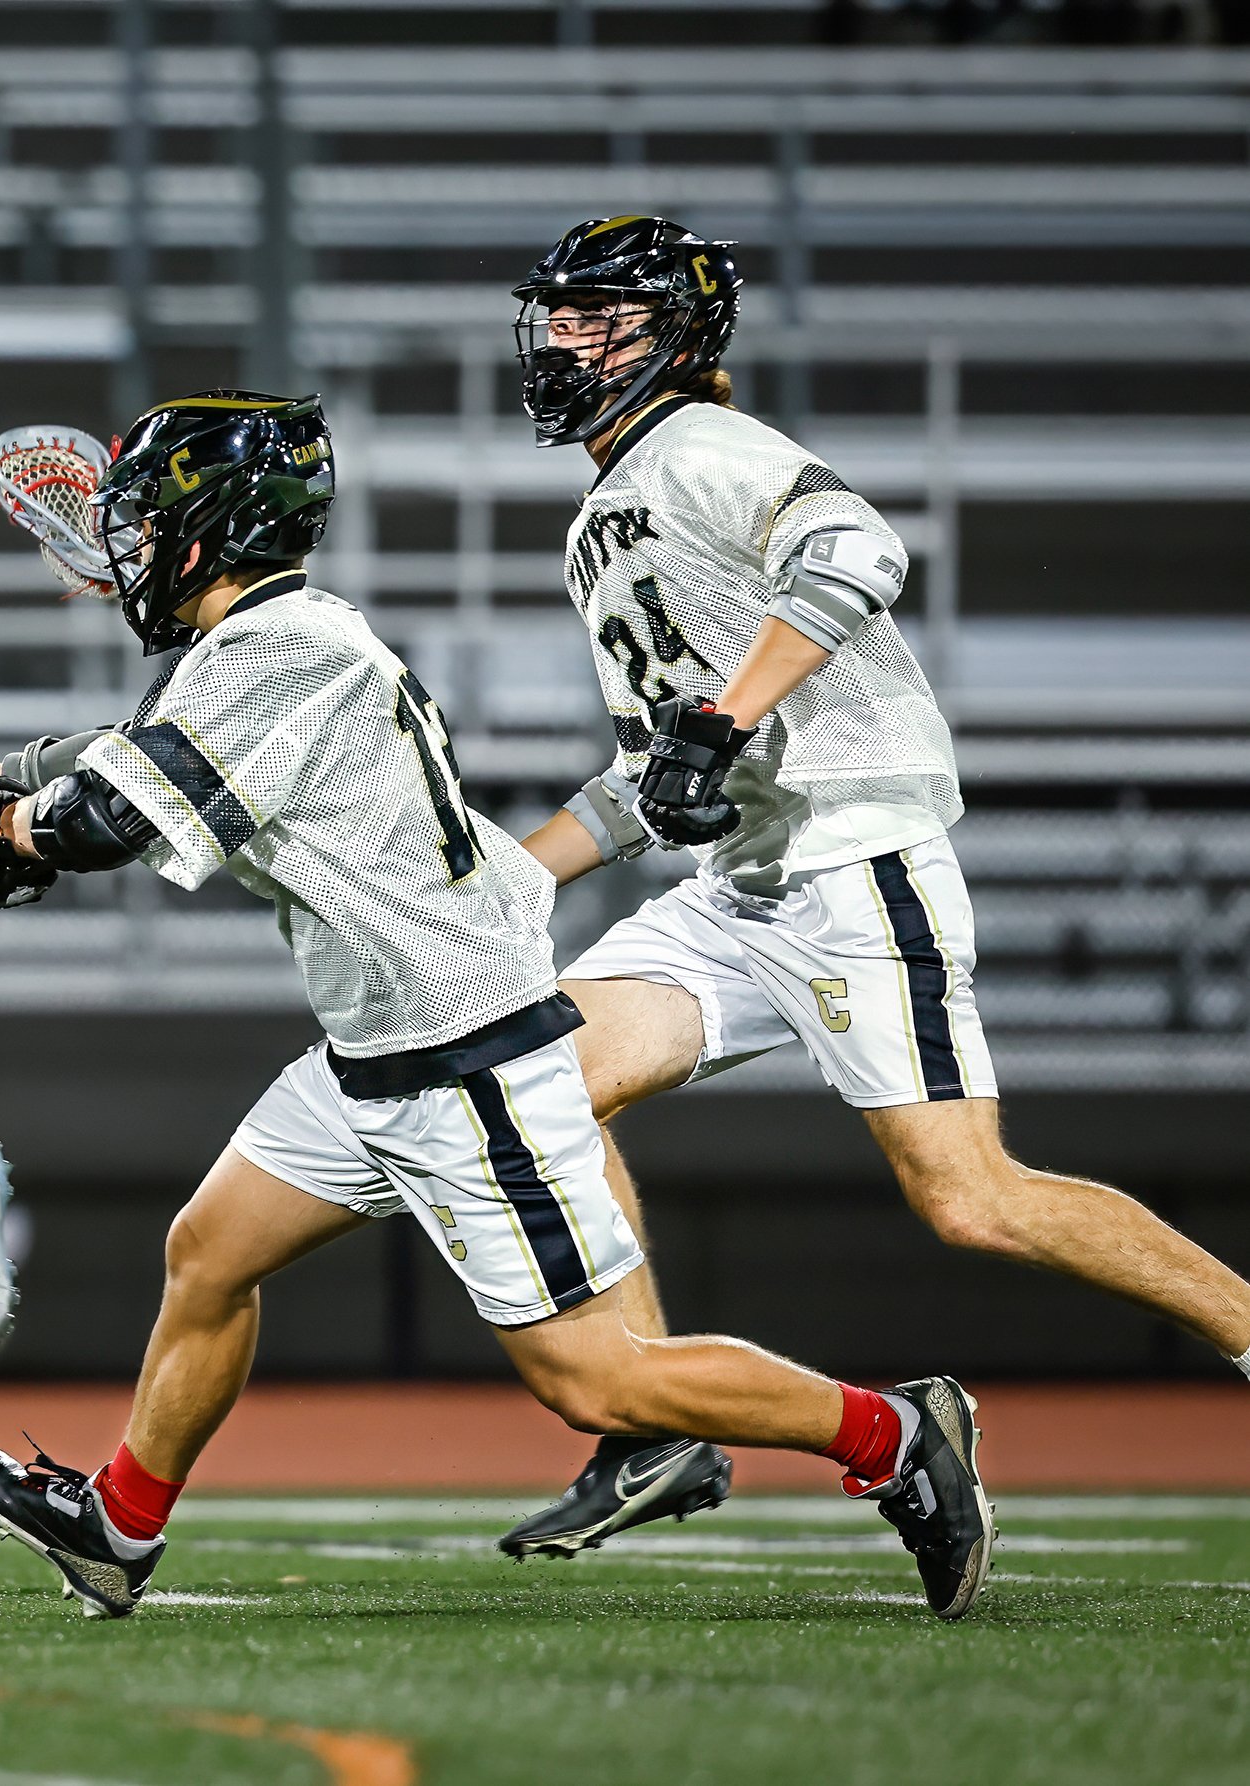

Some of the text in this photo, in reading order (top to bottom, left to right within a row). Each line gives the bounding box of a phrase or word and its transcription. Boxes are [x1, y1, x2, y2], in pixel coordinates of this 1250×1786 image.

[692, 254, 717, 296] C
[170, 447, 200, 493] C
[809, 977, 852, 1033] C
